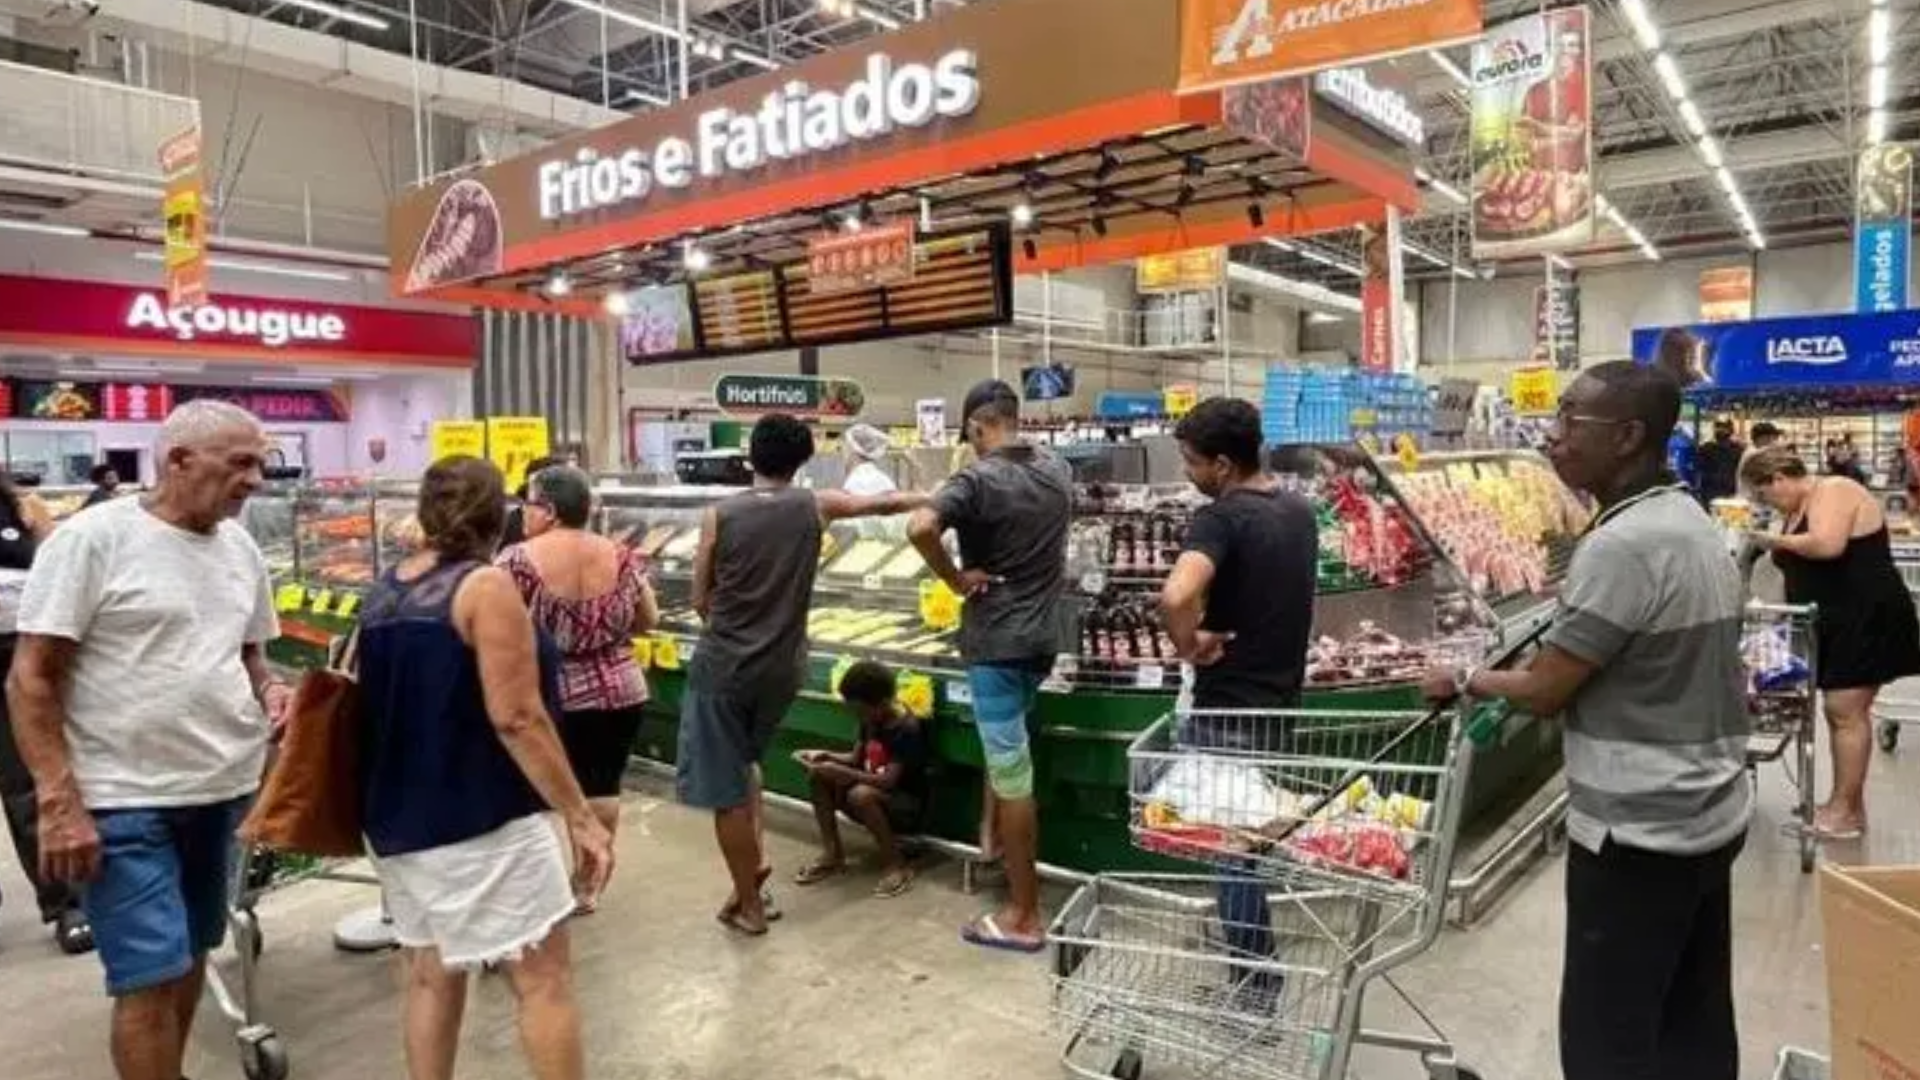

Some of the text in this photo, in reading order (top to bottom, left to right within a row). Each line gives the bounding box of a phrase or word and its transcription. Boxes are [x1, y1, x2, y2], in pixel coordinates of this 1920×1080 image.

[539, 48, 979, 219] Frios e Fatiados
[126, 292, 345, 345] Açougue
[1767, 336, 1848, 364] LACTA
